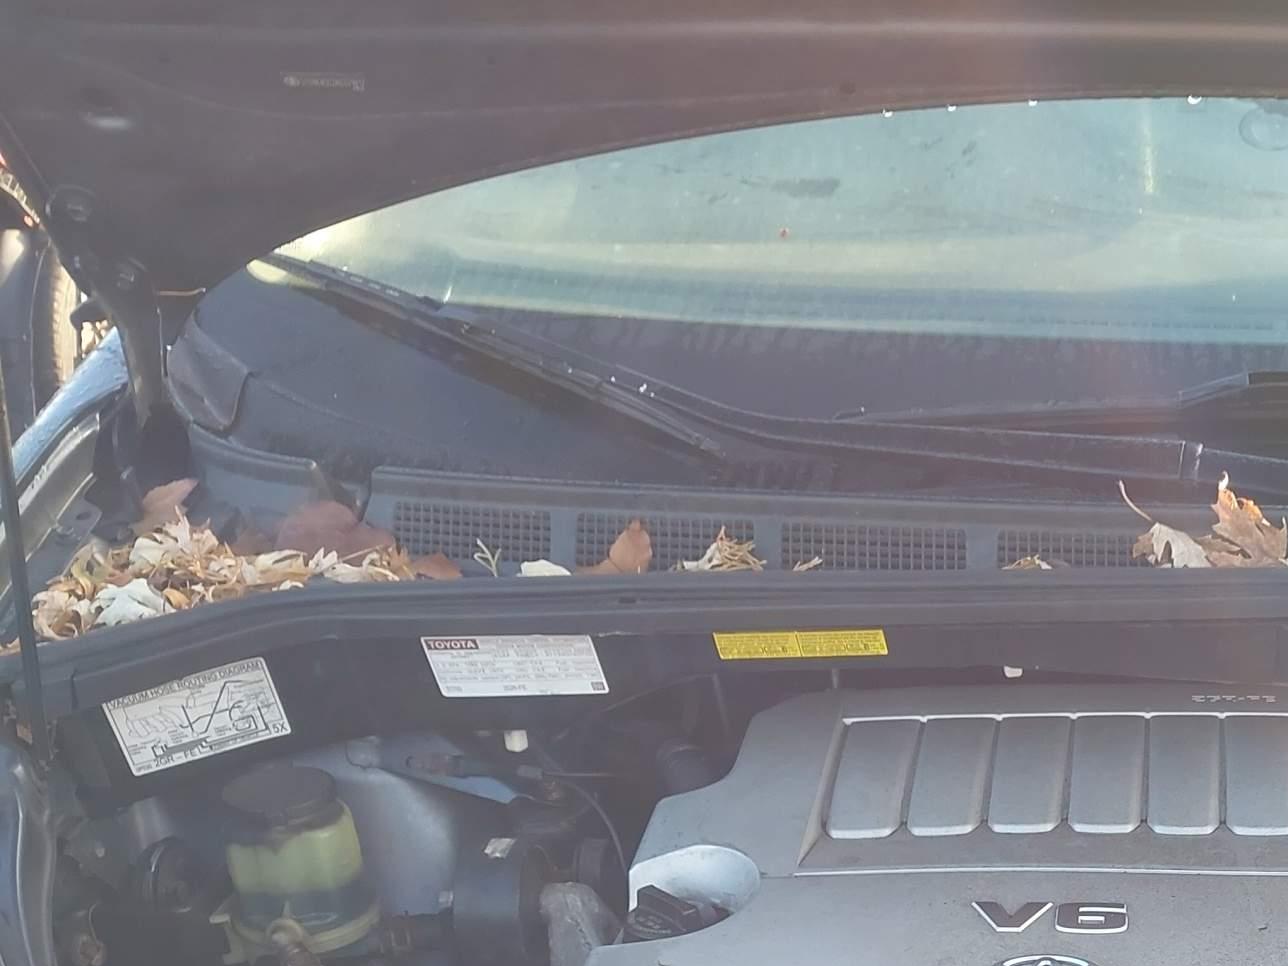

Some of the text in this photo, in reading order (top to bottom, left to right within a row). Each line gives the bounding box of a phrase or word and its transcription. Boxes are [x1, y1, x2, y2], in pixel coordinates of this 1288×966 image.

[427, 639, 476, 649] TOYOTA
[110, 661, 261, 709] VACUUM HOSE ROUTING DIAGRAM
[272, 721, 288, 734] 5X
[971, 901, 1129, 934] V6
